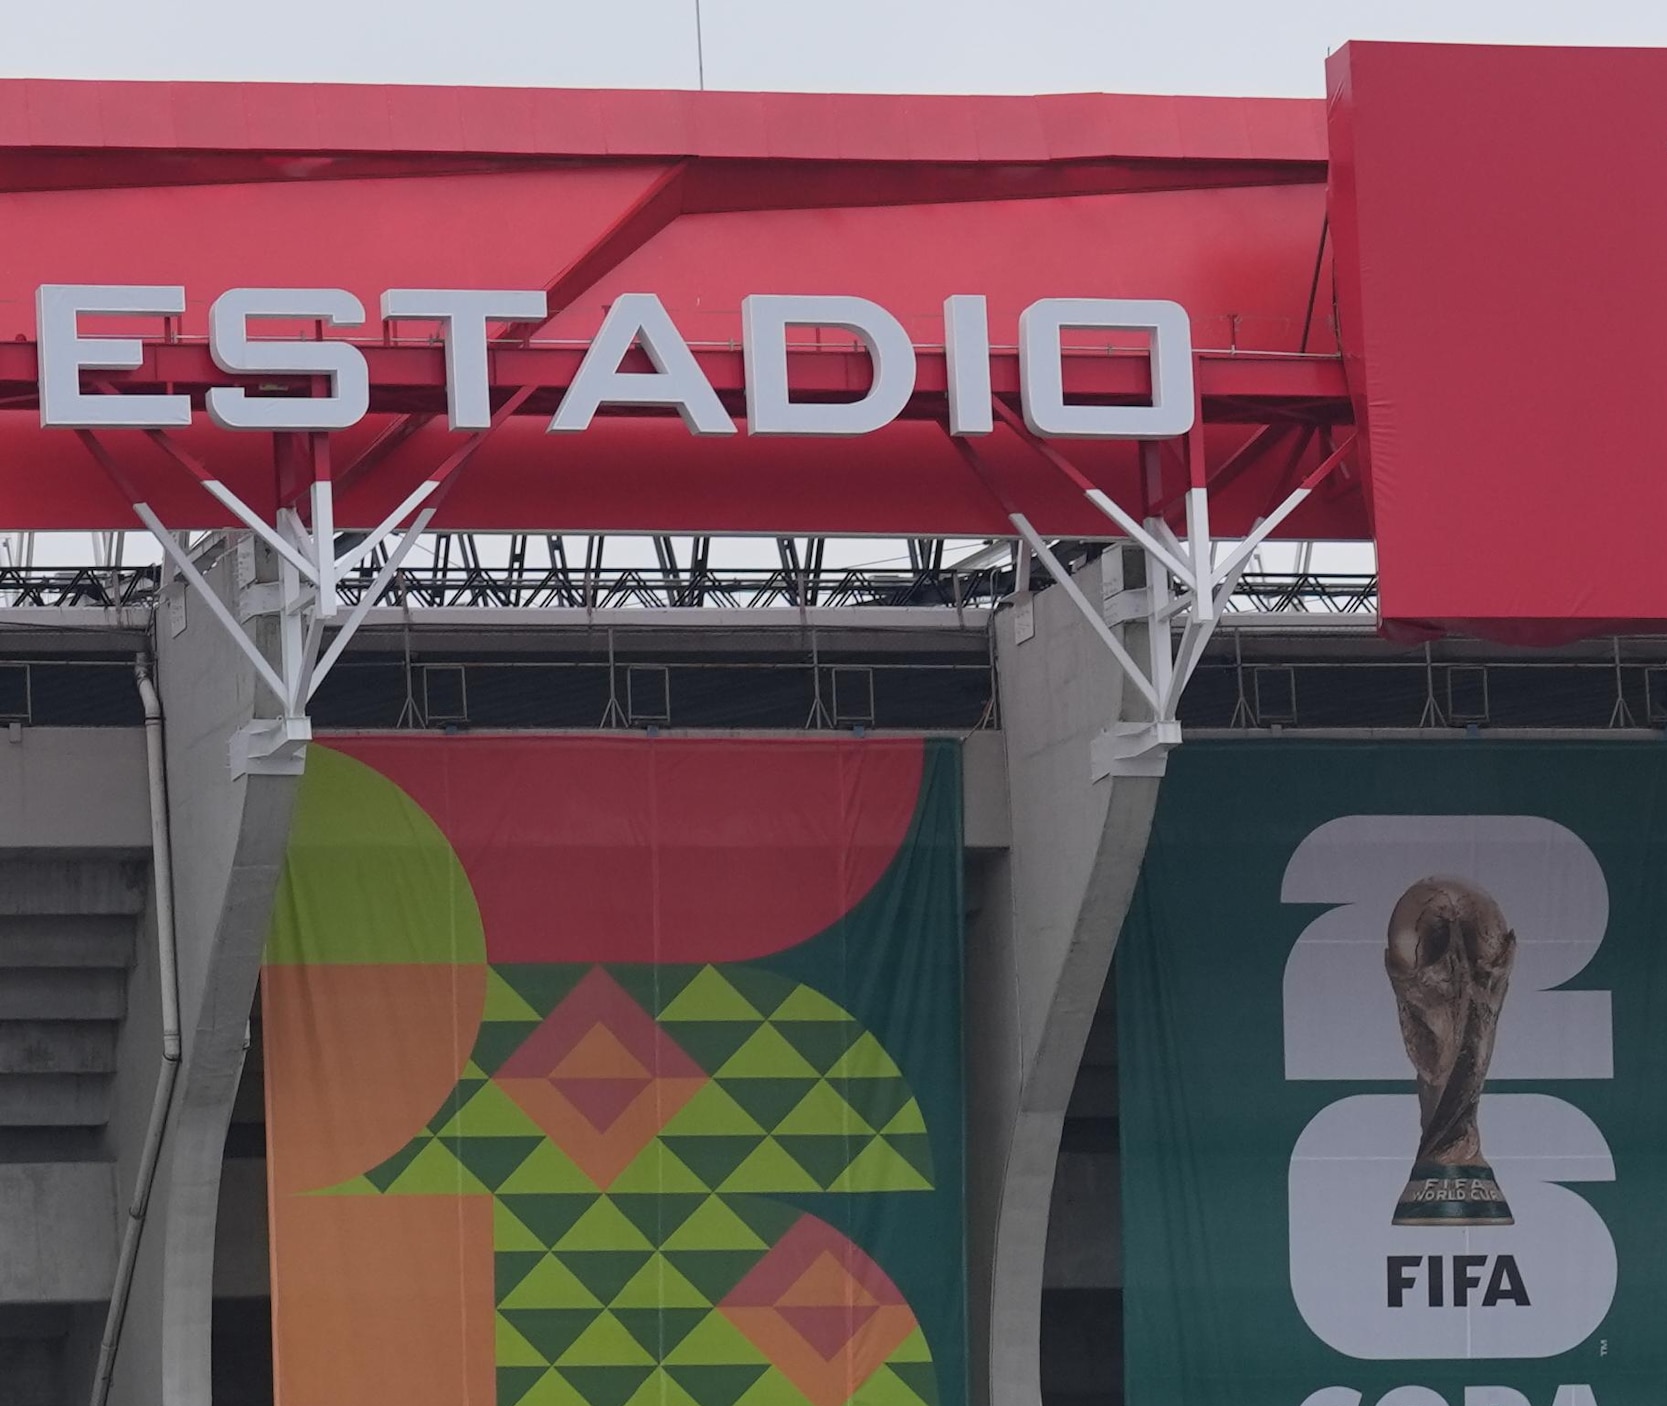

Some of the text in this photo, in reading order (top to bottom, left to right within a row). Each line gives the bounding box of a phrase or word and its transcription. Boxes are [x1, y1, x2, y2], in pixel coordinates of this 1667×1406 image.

[36, 283, 1195, 440] ESTADIO
[1412, 1190, 1499, 1200] WORLD CUP
[1425, 1178, 1485, 1191] FIFA
[1386, 1255, 1531, 1308] FIFA
